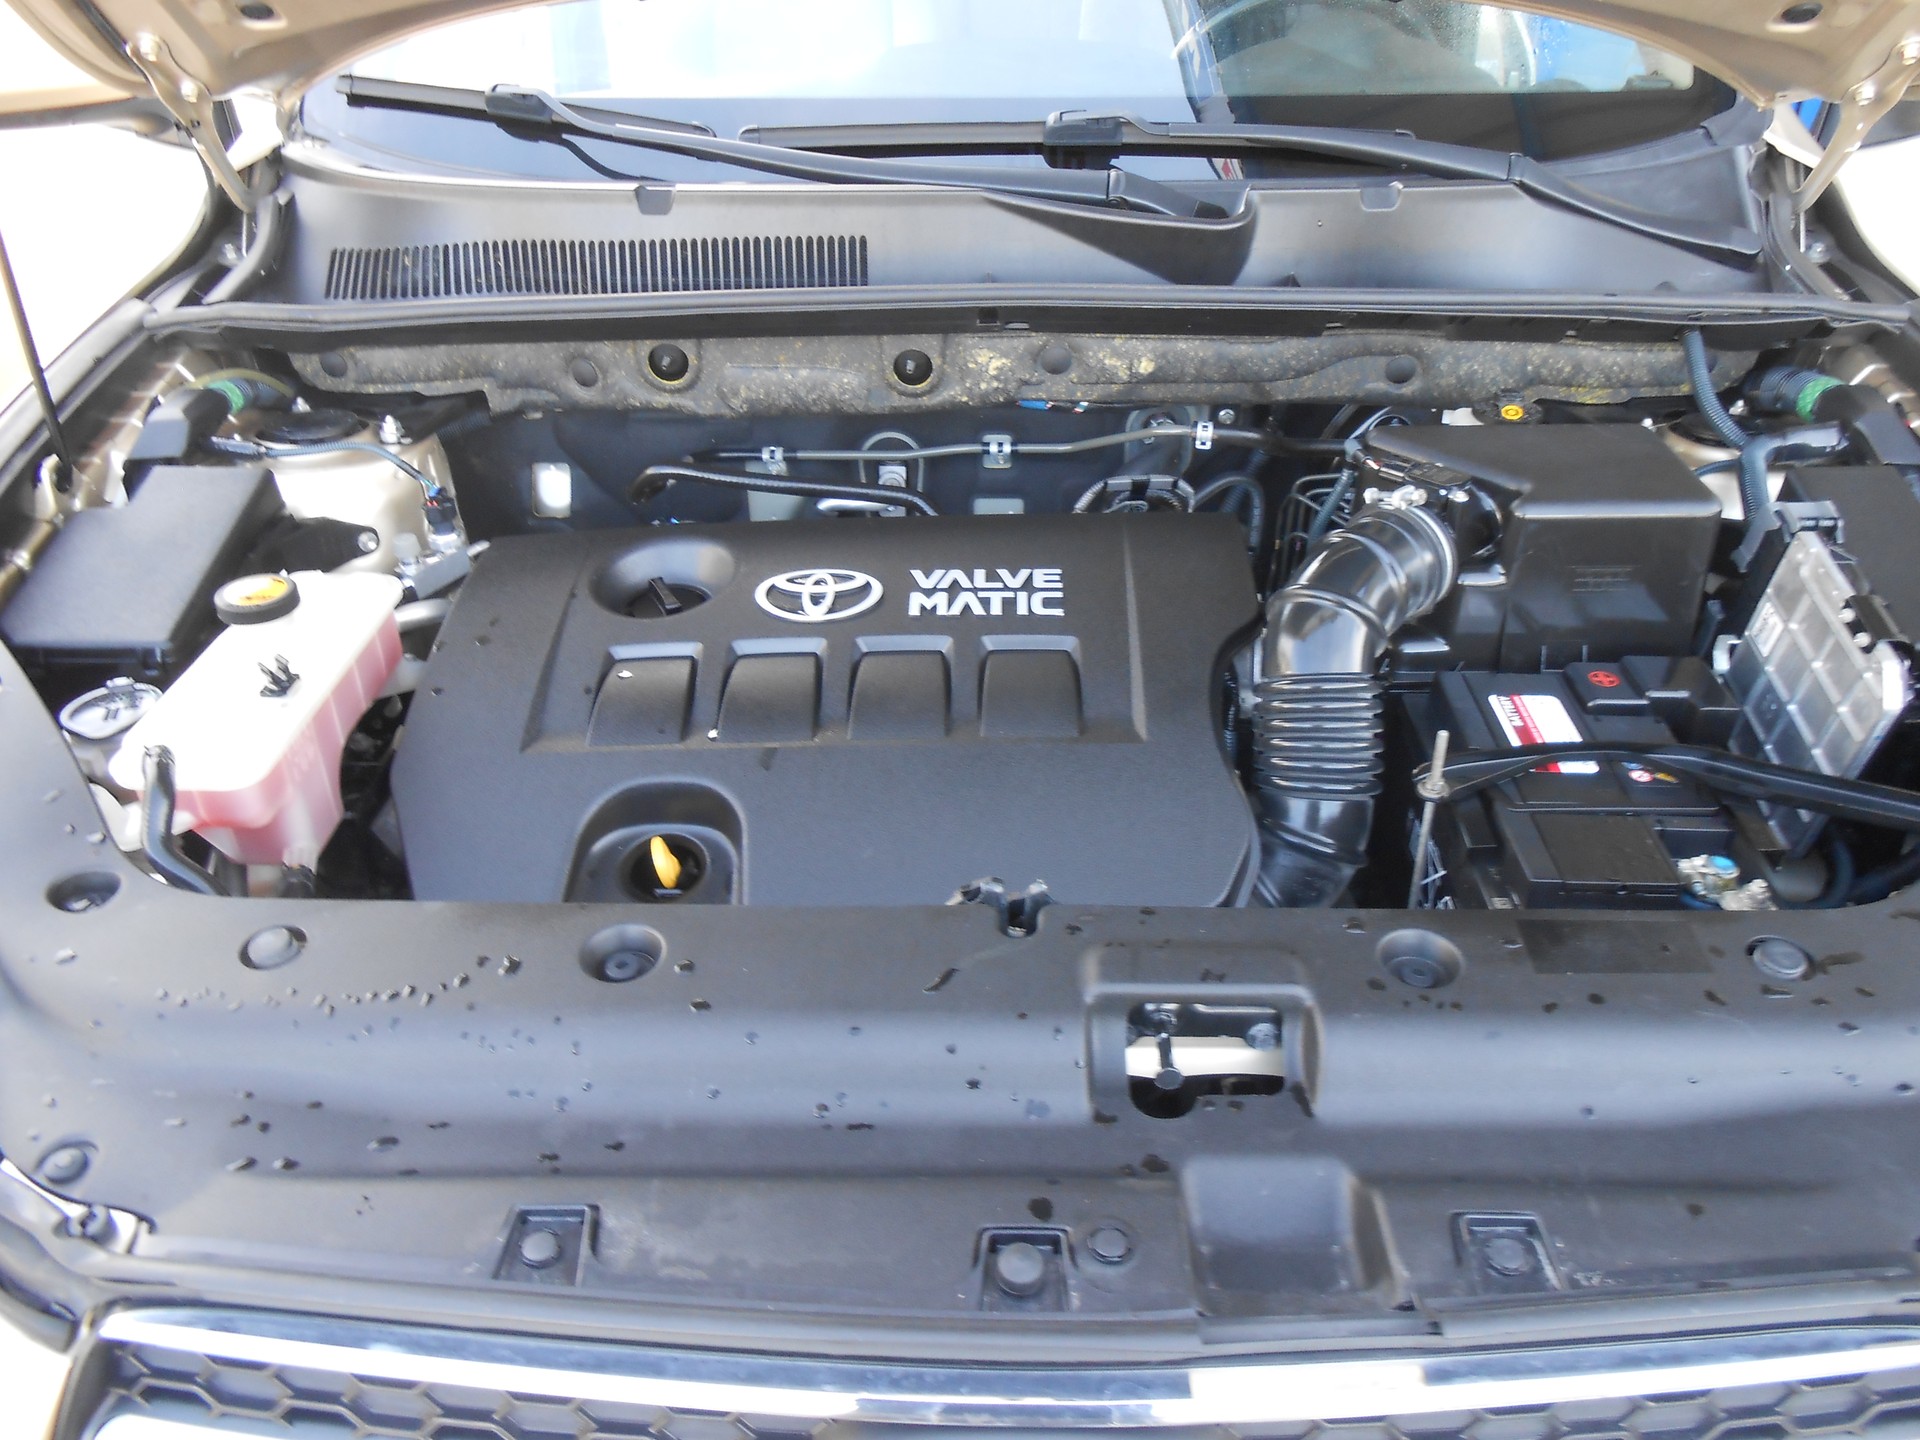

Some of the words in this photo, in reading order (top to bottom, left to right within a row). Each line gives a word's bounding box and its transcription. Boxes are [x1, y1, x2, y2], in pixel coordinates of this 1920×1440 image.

[909, 568, 1064, 589] VALVE
[907, 591, 1065, 616] MATIC
[1498, 695, 1524, 727] BATTERY
